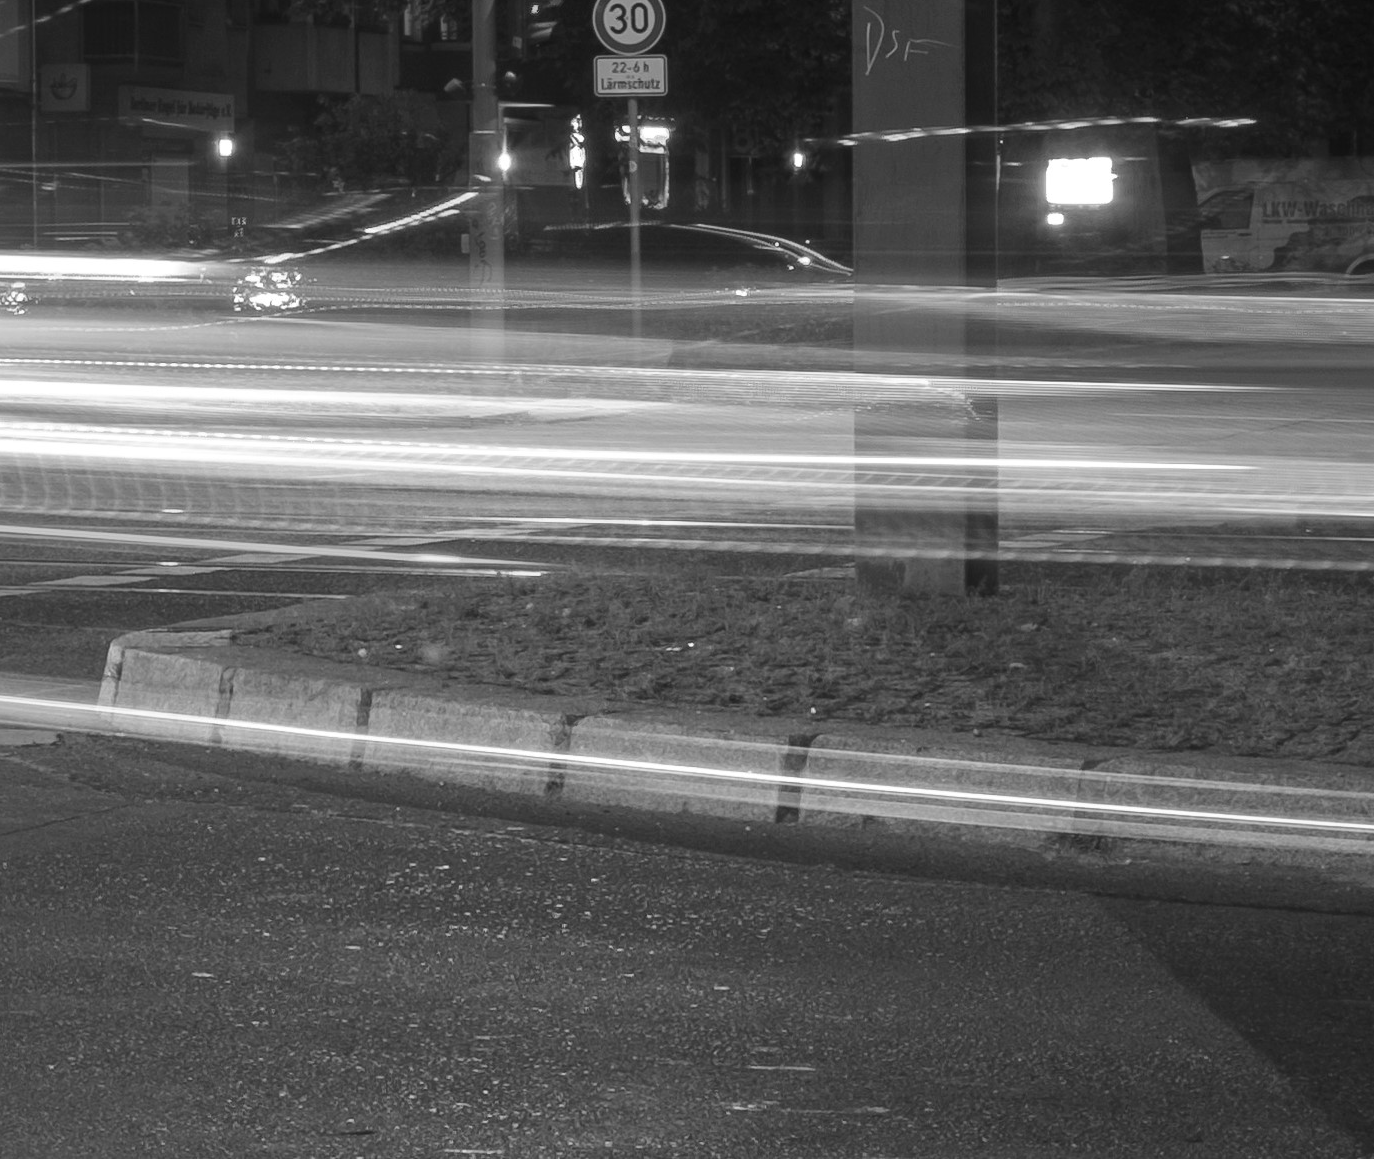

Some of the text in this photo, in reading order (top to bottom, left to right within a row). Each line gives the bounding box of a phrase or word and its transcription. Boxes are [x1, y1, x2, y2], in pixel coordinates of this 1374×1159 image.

[609, 2, 649, 35] 30
[611, 61, 650, 73] 22-6 h
[601, 78, 661, 90] Lärmschutz
